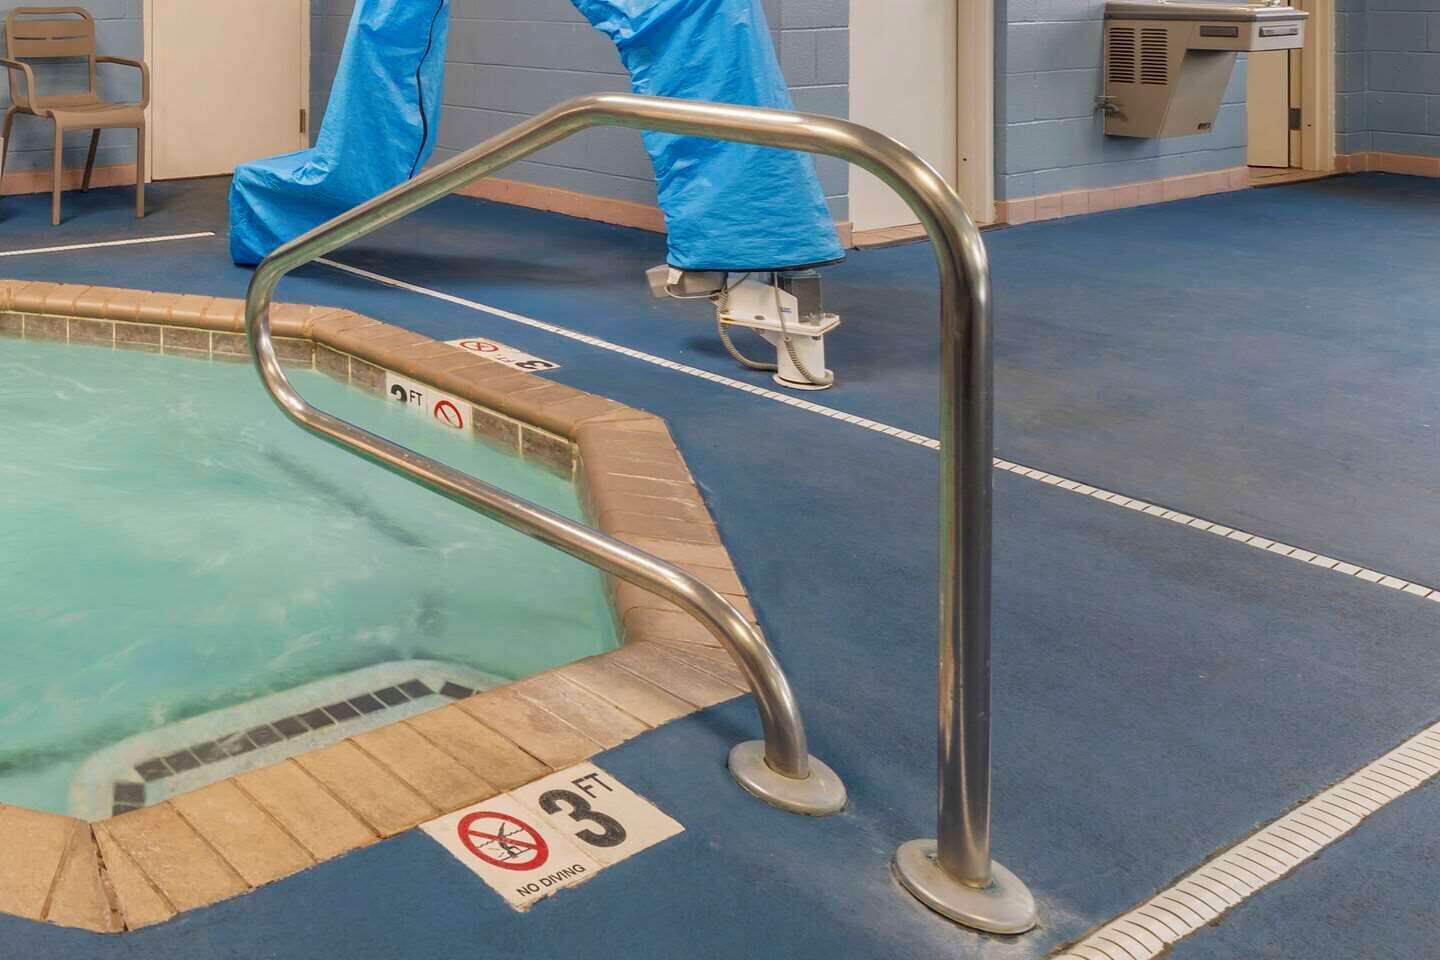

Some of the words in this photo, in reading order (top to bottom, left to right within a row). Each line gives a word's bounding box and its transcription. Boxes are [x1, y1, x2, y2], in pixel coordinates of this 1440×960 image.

[409, 390, 422, 406] FT
[572, 772, 613, 799] FT
[539, 789, 627, 848] 3
[516, 881, 541, 897] NO
[539, 863, 586, 888] DIVING
